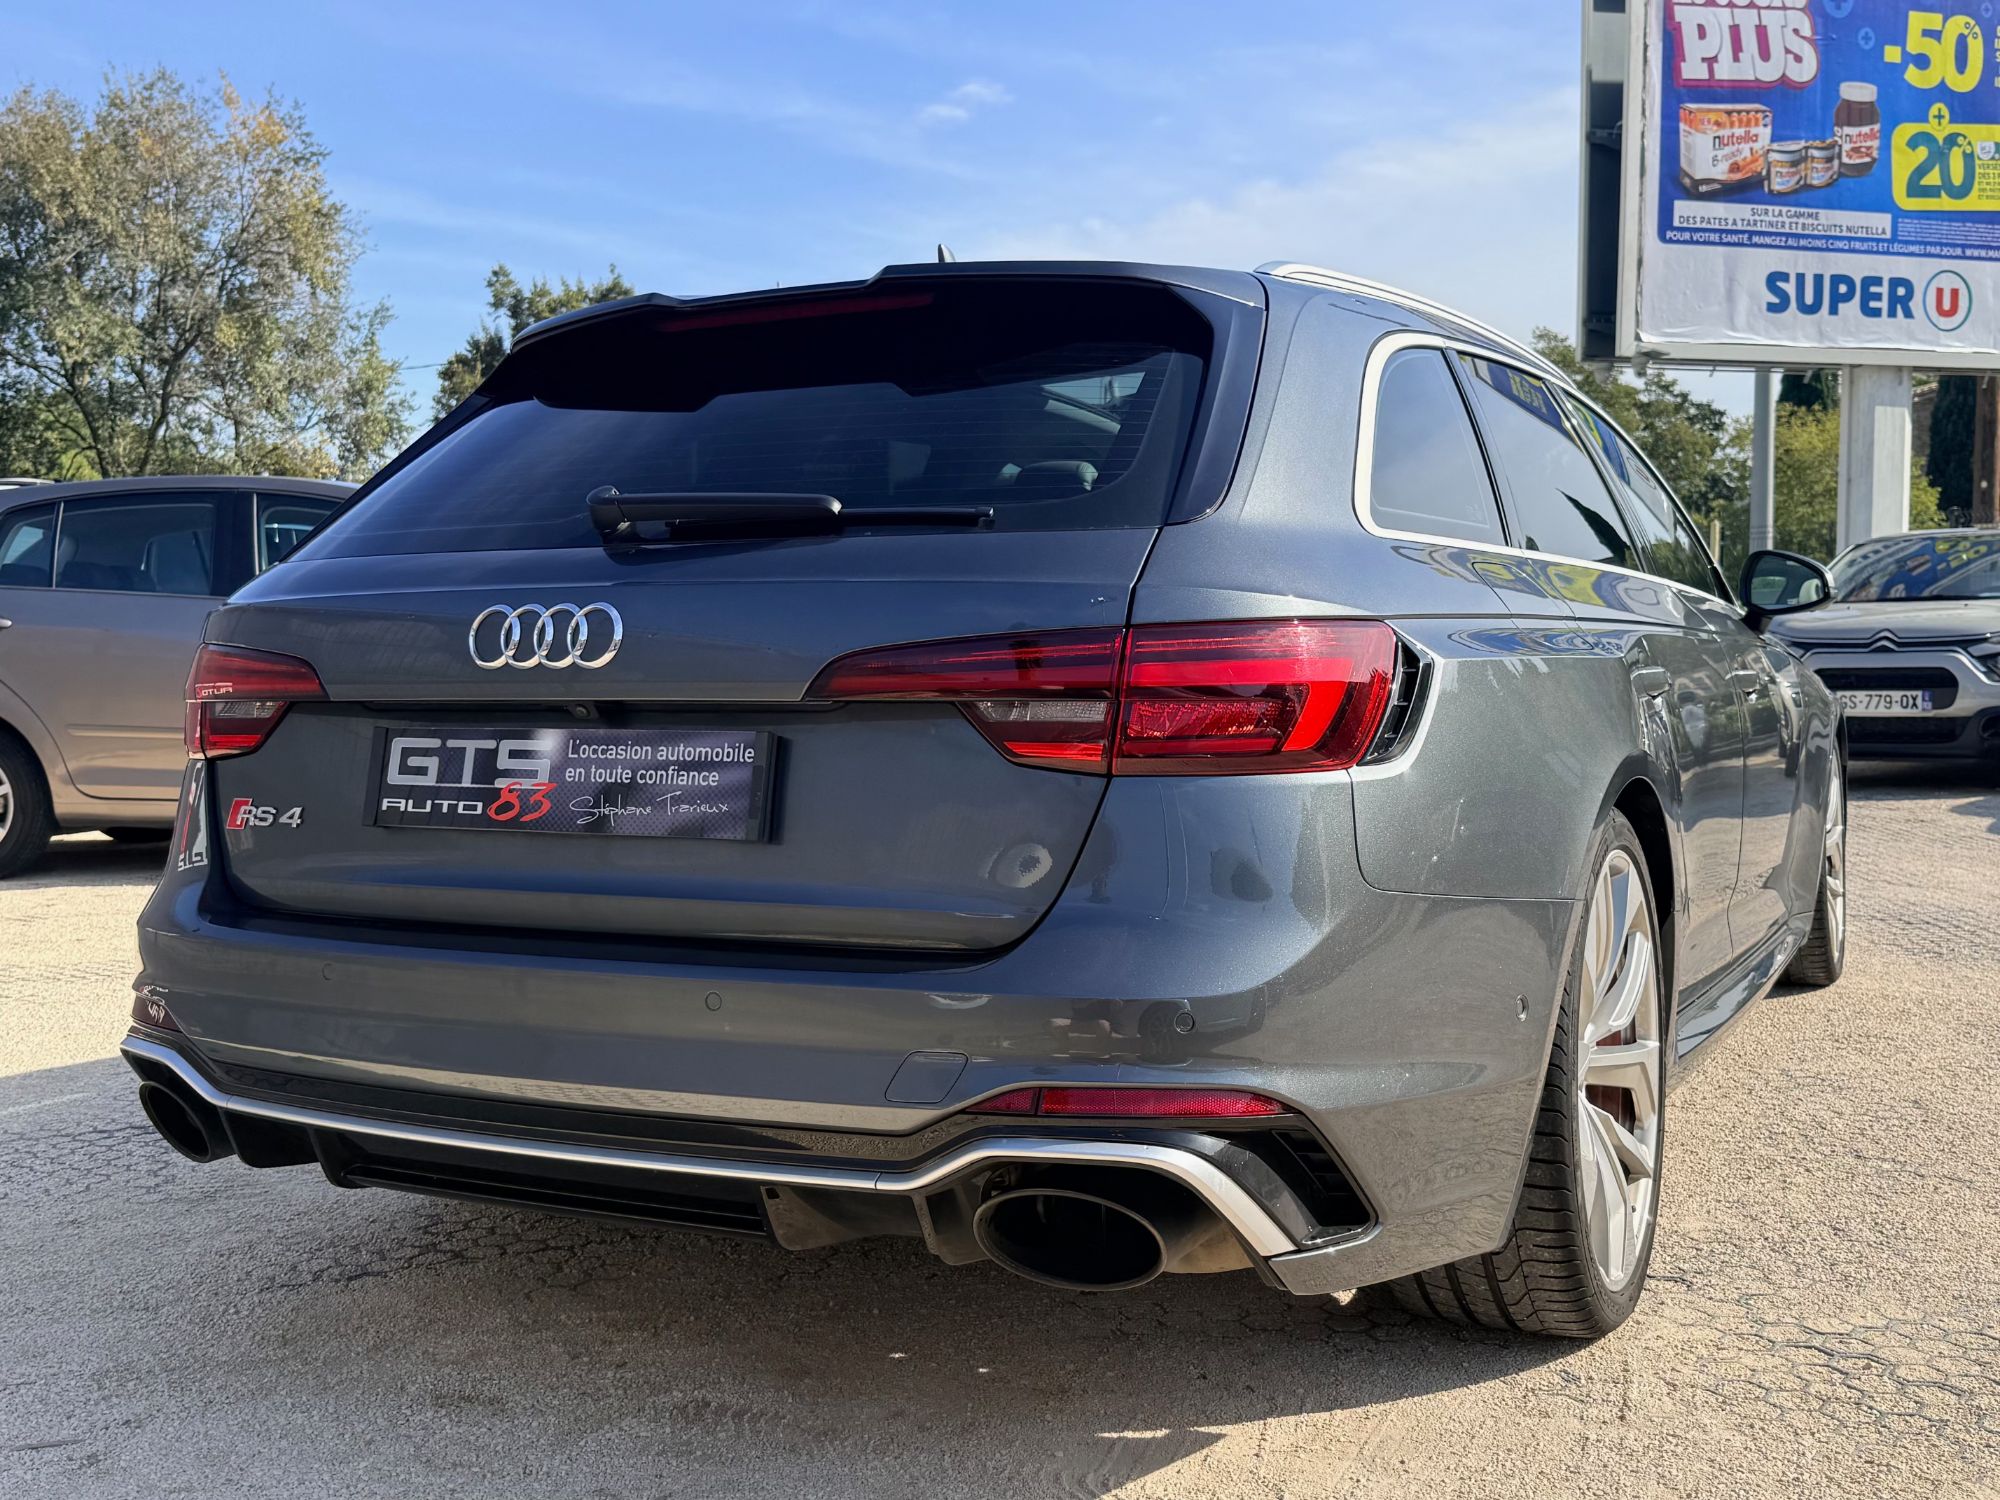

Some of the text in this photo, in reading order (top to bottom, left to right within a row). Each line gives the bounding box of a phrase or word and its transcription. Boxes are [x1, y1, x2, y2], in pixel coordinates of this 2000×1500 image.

[1673, 4, 1818, 83] PLUS
[1713, 130, 1759, 150] nutella
[1678, 215, 1887, 236] DES PATES A TARTINER ET BISCUITS NUTELLA
[1751, 207, 1820, 221] SUR LA GAMME
[1666, 230, 1690, 241] POUR
[1692, 231, 1720, 242] VOTRE
[1752, 234, 1786, 246] MANGEZ
[1787, 236, 1798, 246] AU
[1800, 237, 1827, 248] MOINS
[1828, 240, 1849, 250] CINQ
[1851, 241, 1877, 252] FRUITS
[1878, 243, 1889, 252] ET
[1890, 242, 1925, 254] LÉGUMES
[1765, 270, 1960, 319] SUPER U
[387, 737, 551, 788] GTS
[568, 739, 755, 762] L'occasion automobile
[565, 765, 720, 786] en toute confiance
[381, 781, 558, 822] AUTO 83
[569, 791, 729, 827] Stéphane Trarieux
